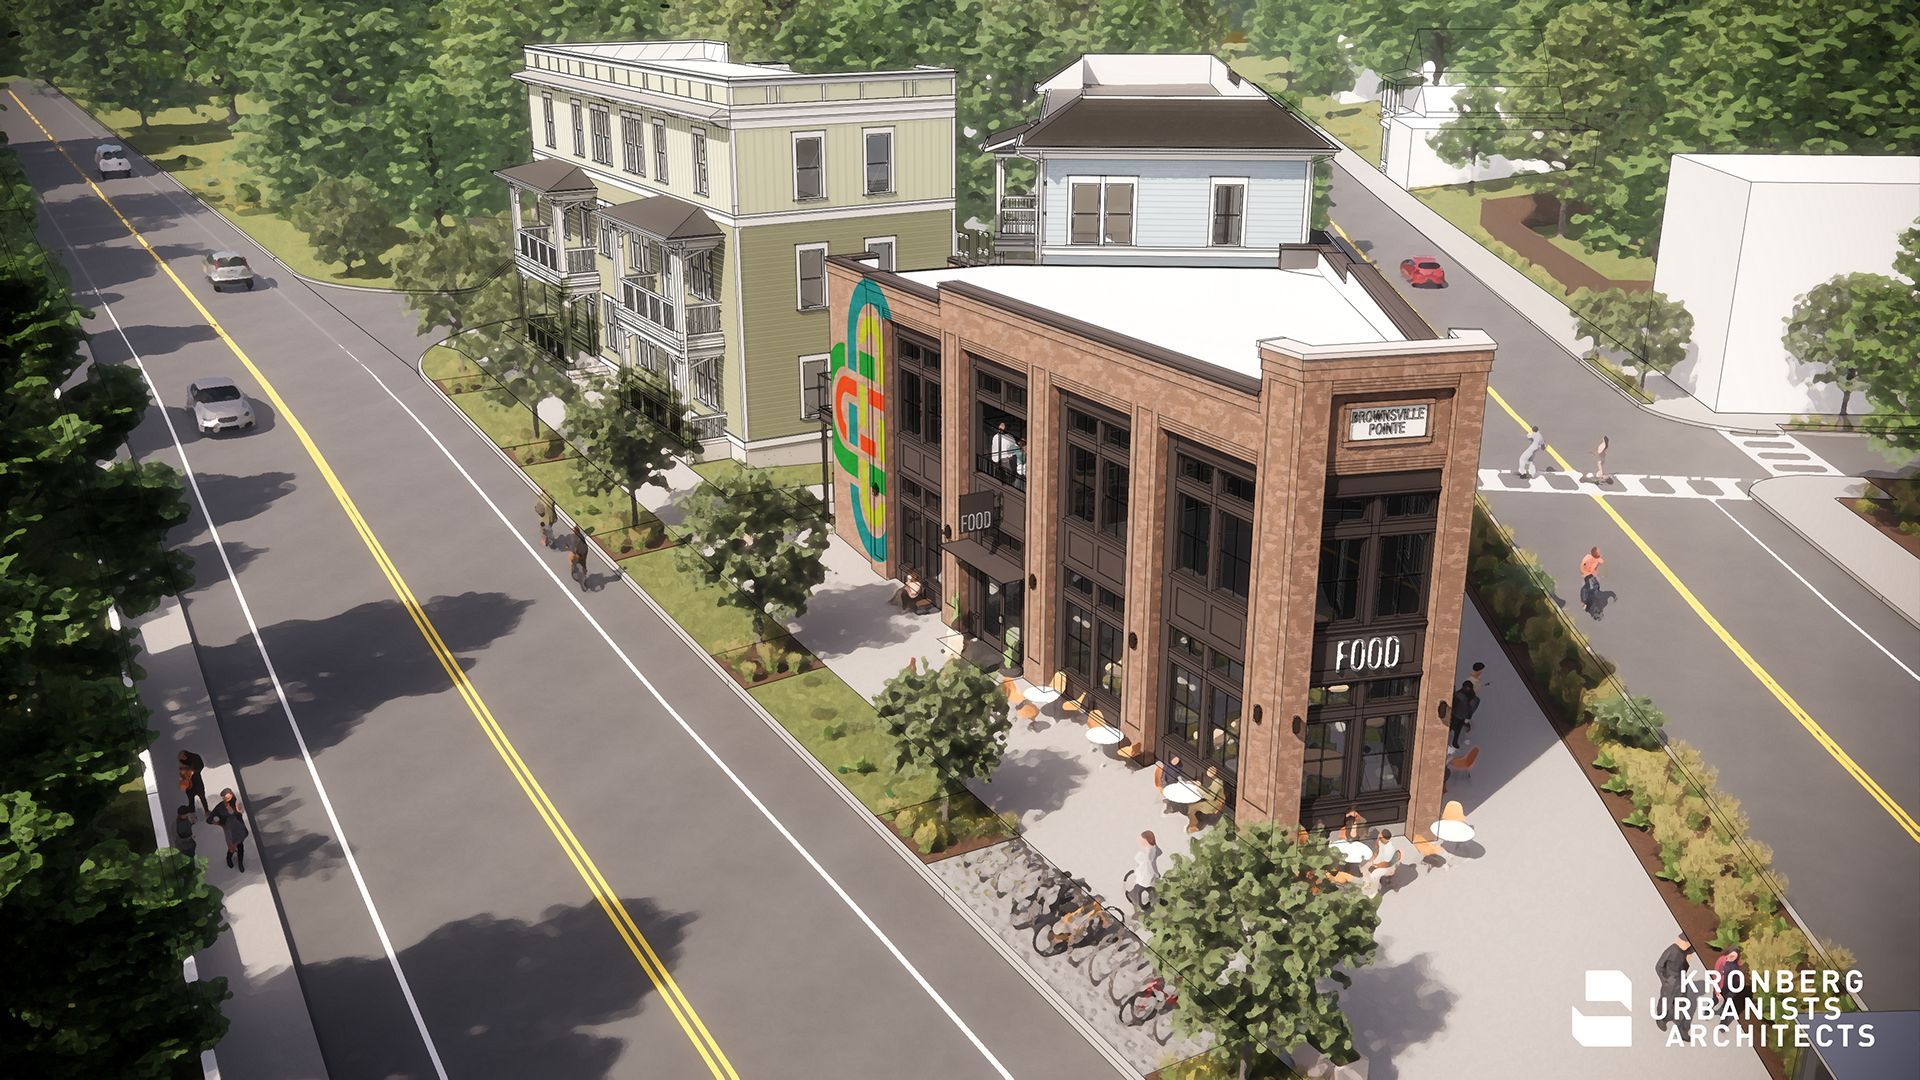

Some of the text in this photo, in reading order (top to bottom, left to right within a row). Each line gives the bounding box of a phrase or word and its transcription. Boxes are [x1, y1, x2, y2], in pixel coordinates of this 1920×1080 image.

[1352, 407, 1425, 423] BROWNSVILLE
[1369, 422, 1406, 436] POINTE
[961, 511, 991, 532] FOOD
[1336, 636, 1400, 673] FOOD
